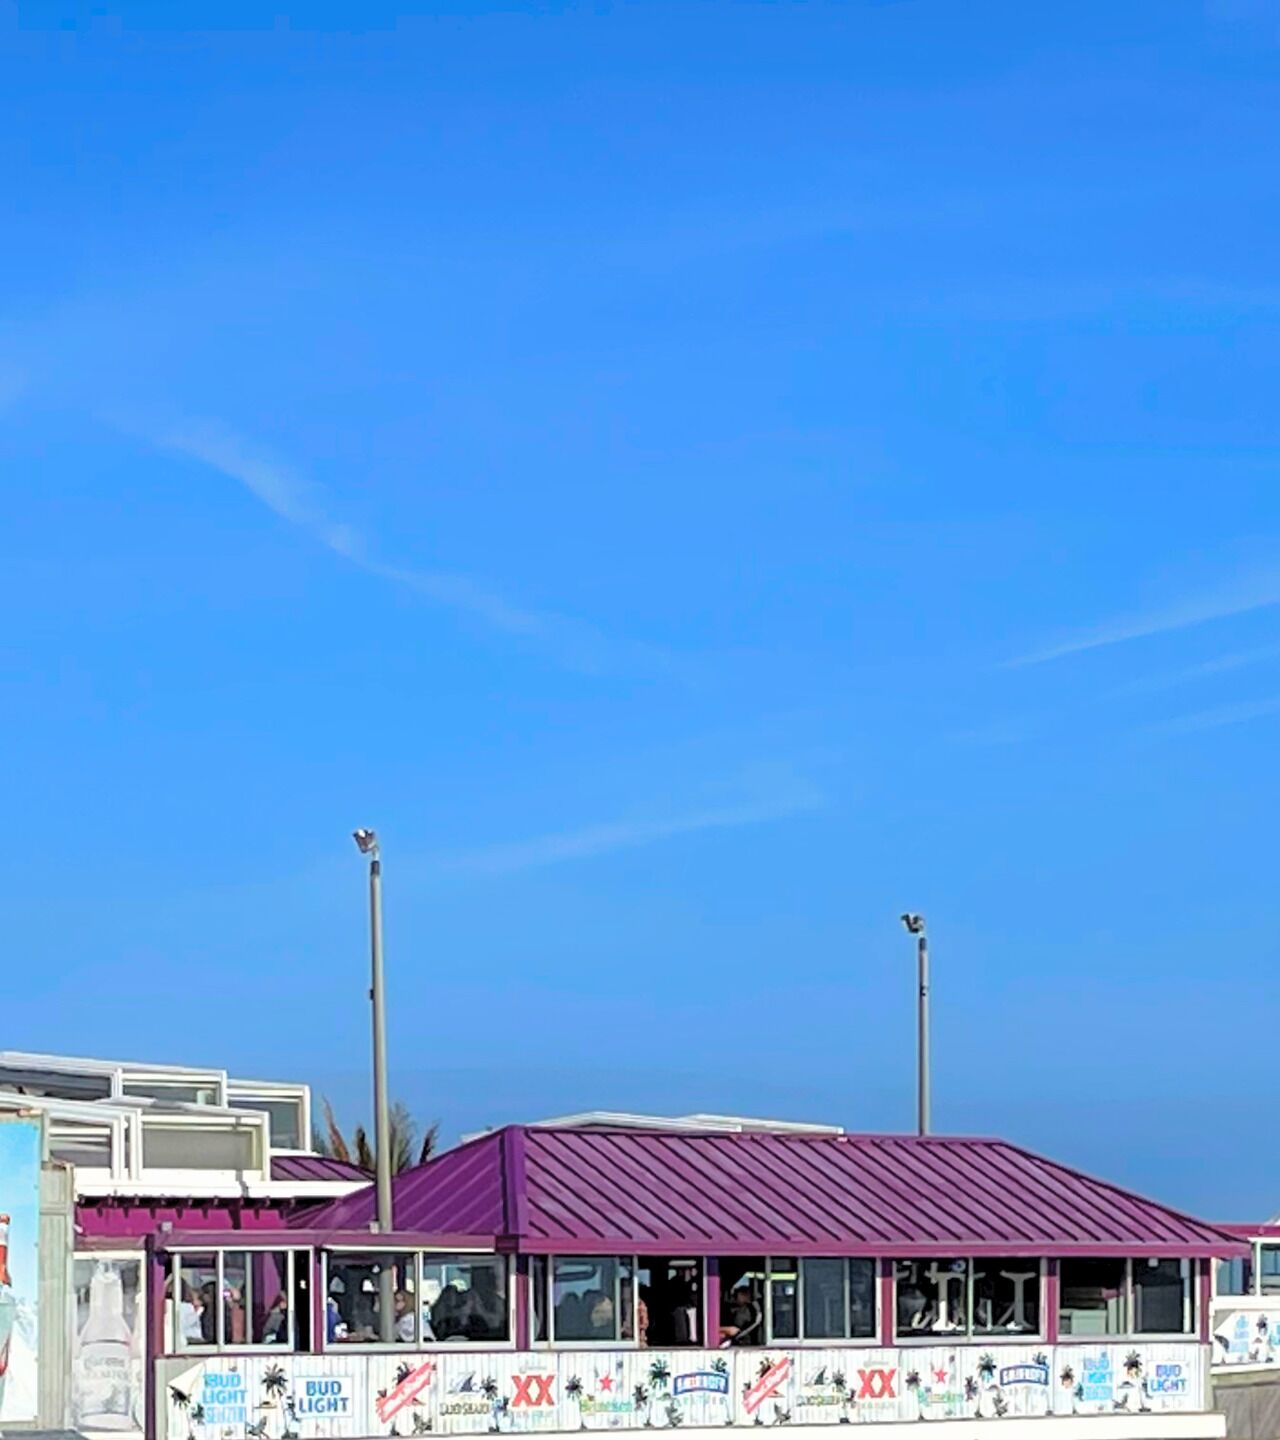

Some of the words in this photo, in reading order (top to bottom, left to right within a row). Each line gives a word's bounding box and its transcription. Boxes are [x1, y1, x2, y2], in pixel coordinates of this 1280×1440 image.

[205, 1374, 241, 1388] BUD
[306, 1381, 342, 1396] BUD
[857, 1369, 897, 1399] XX
[1150, 1379, 1187, 1392] LIGHT
[203, 1390, 246, 1404] LIGHT
[511, 1375, 555, 1407] XX
[298, 1398, 349, 1413] LIGHT
